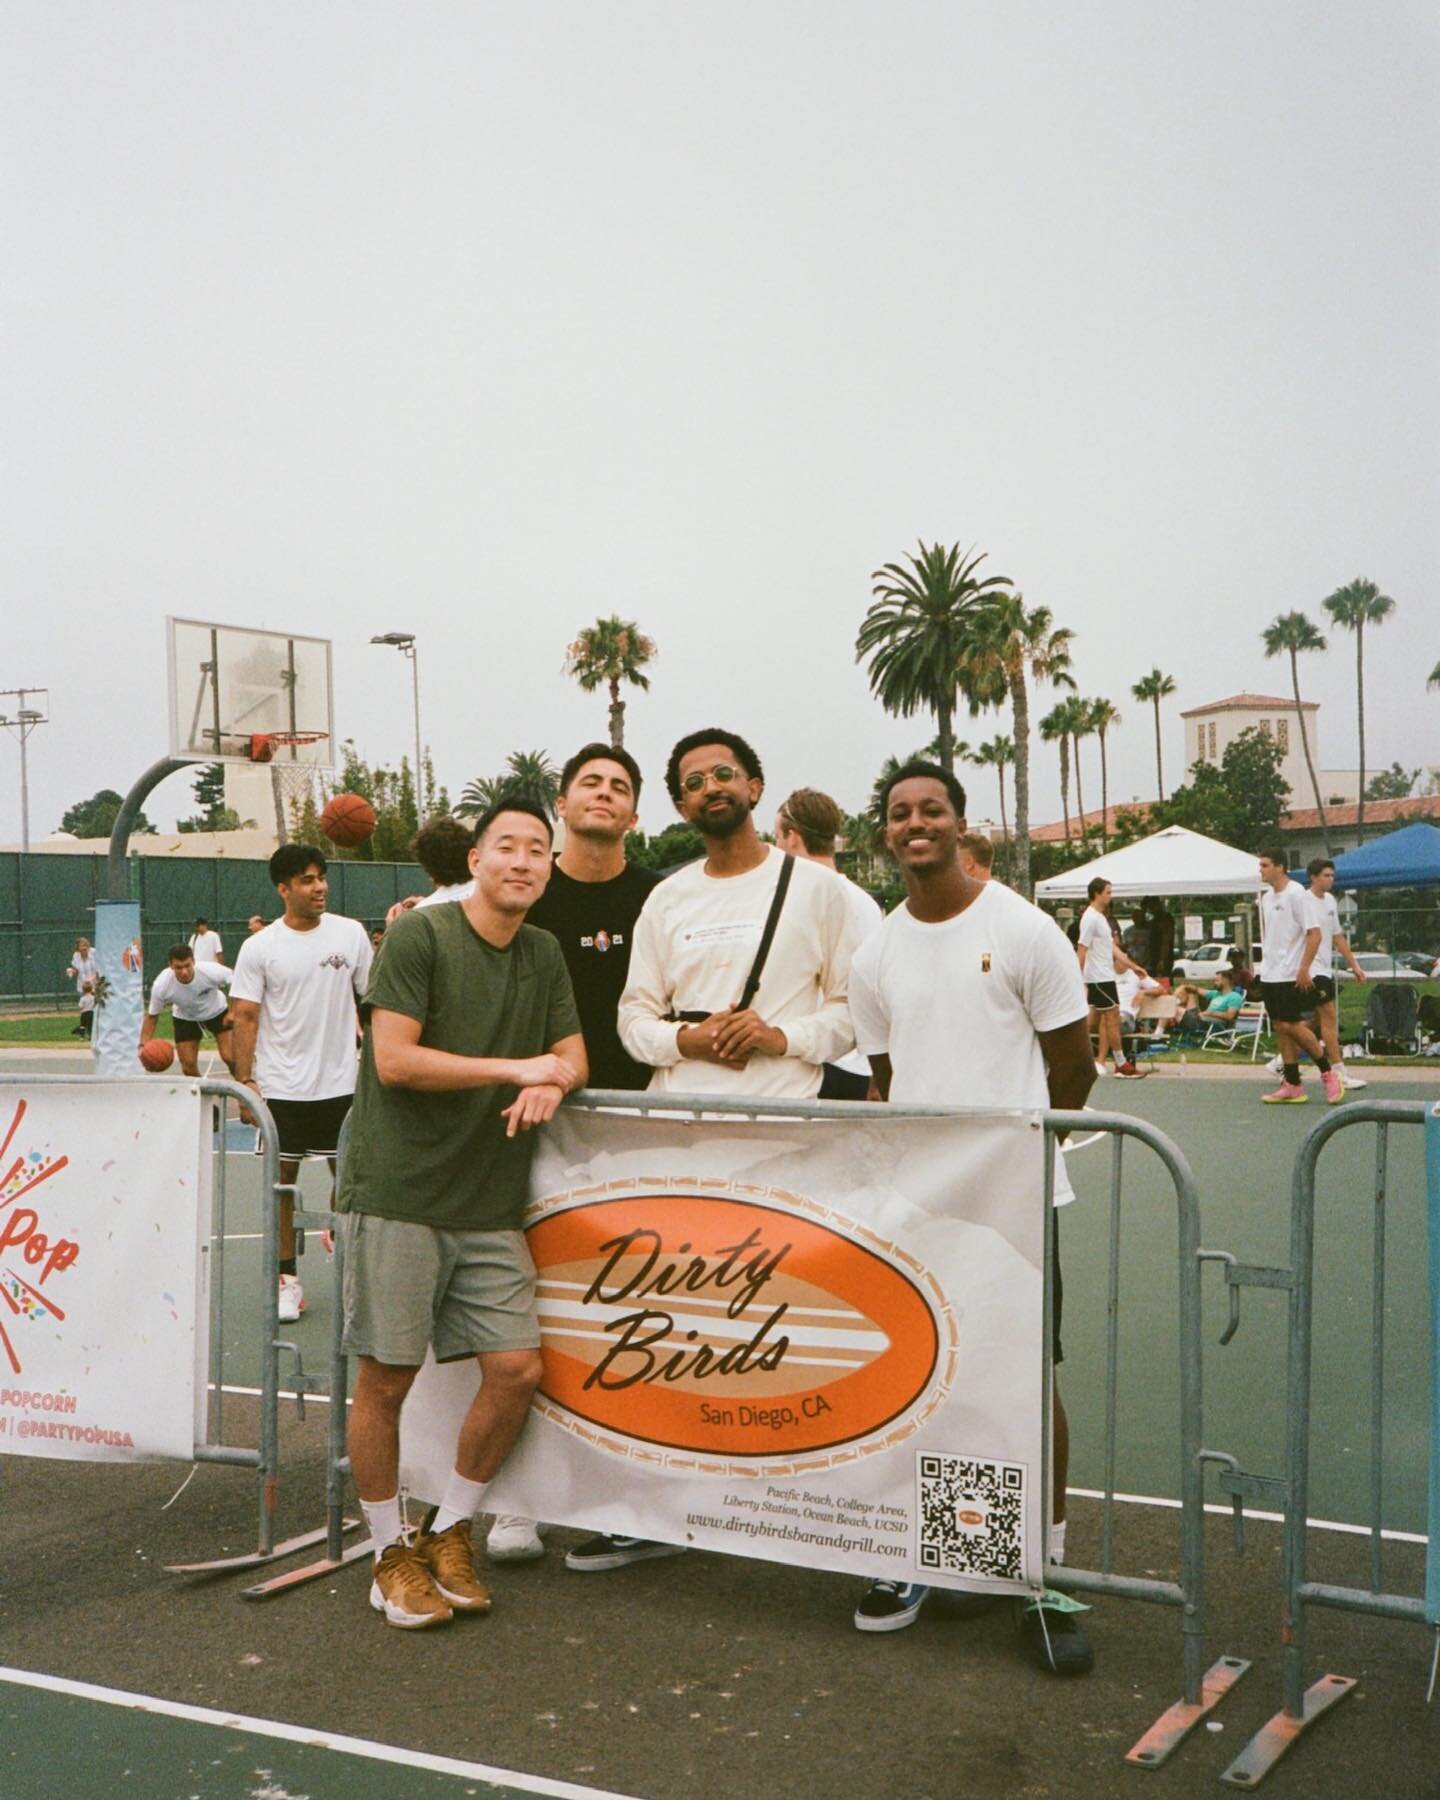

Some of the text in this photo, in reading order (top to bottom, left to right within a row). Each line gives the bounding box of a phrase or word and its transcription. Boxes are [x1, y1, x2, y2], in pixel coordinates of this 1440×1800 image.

[582, 1226, 791, 1318] Dirty
[583, 1303, 790, 1391] Birds
[0, 1388, 78, 1414] POPCORN
[700, 1394, 832, 1431] San Diego, CA
[17, 1419, 134, 1448] @PARTYPOPUSA
[723, 1495, 909, 1533] Liberty Station, Ocean Beach, UCSD
[766, 1486, 908, 1518] Pacific Beach, College Area,
[686, 1512, 908, 1558] www.dirtybirdsbarandgrill.com
